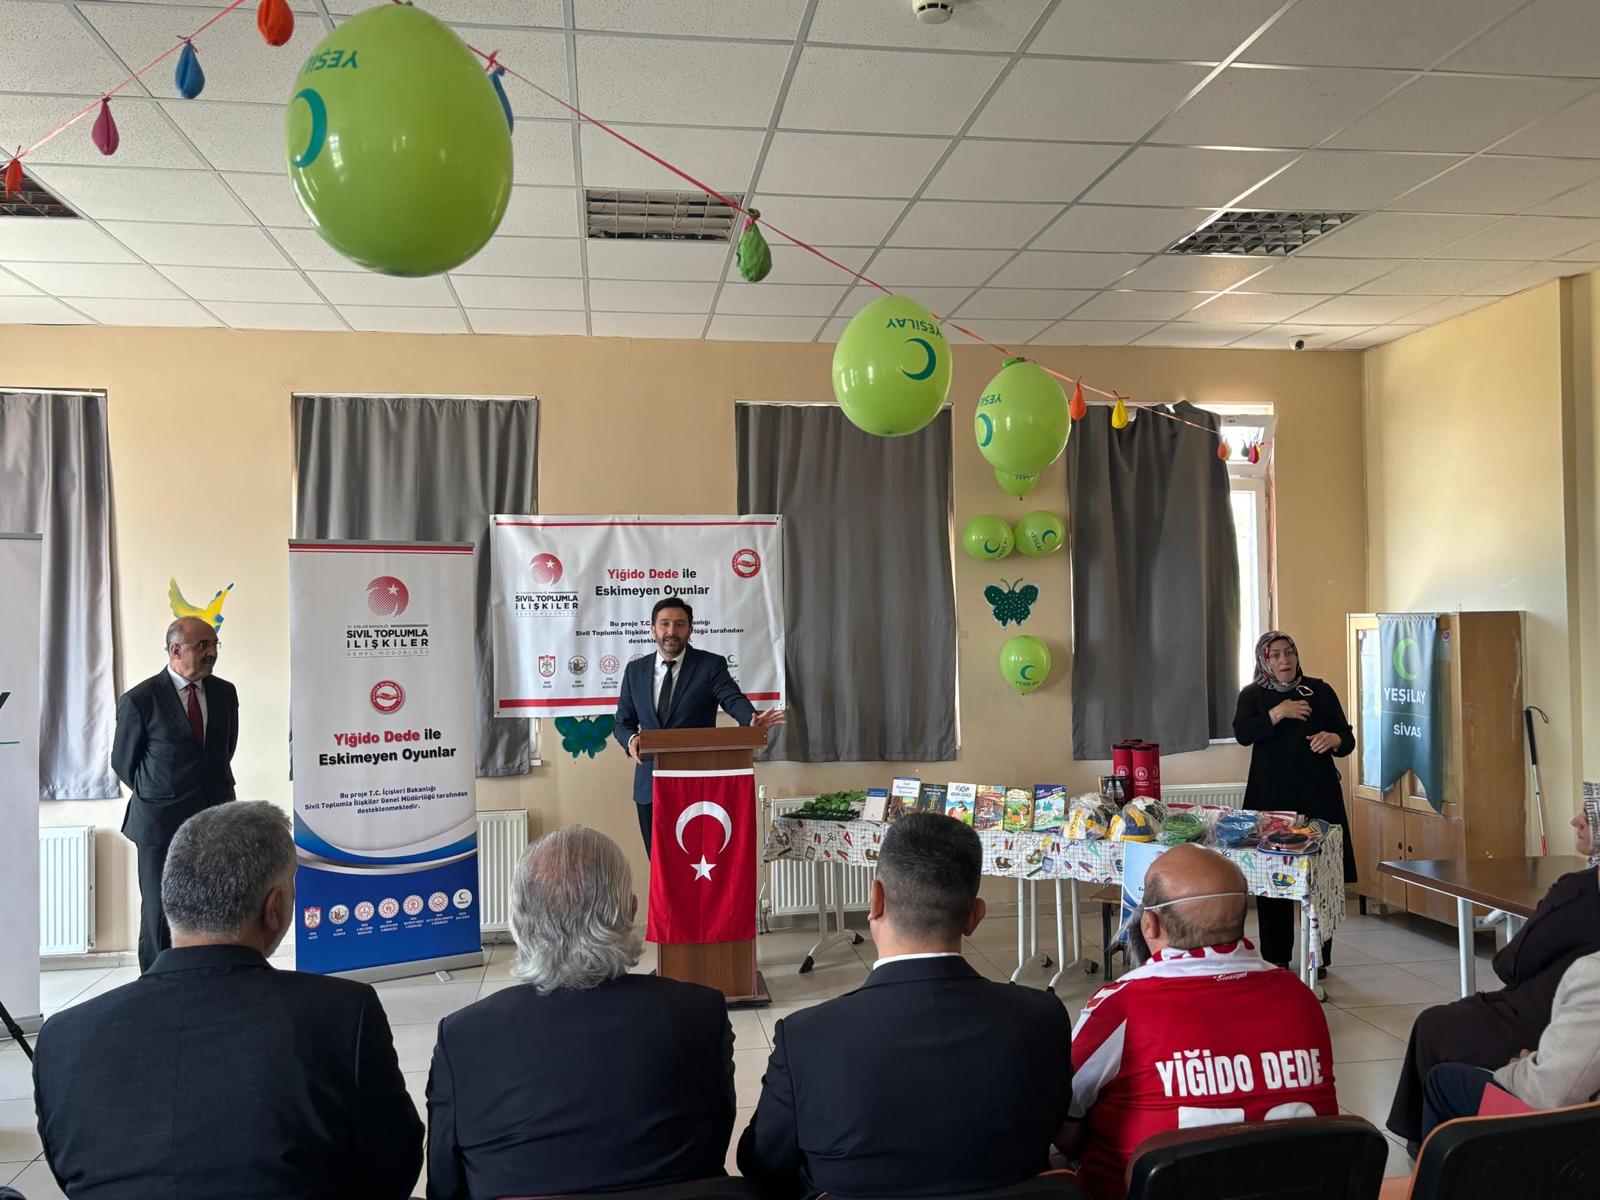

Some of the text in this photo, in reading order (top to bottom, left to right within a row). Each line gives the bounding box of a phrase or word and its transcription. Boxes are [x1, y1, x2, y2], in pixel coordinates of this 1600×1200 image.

[607, 568, 697, 581] Yiğido Dede ile
[595, 584, 710, 597] Eskimeyen Oyunlar
[515, 602, 579, 611] İLİŞKİLER
[346, 629, 429, 638] SİVİL TOPLUMLA
[624, 628, 650, 636] İlişkiler
[346, 638, 429, 649] İLİŞKİLER
[1383, 687, 1426, 705] YEŞİLAY
[1393, 722, 1422, 738] SİVAS
[333, 728, 442, 748] Yiğido Dede ile
[319, 746, 457, 766] Eskimeyen Oyunlar
[350, 790, 368, 799] proje
[382, 788, 406, 796] İçişleri
[407, 785, 436, 794] Bakanlığı
[304, 791, 468, 810] Sivil Toplumla İlişkiler Genel Müdürlüğü tarafından
[357, 803, 421, 814] desteklenmektedir.
[1155, 1048, 1324, 1097] YİĞİDO DEDE
